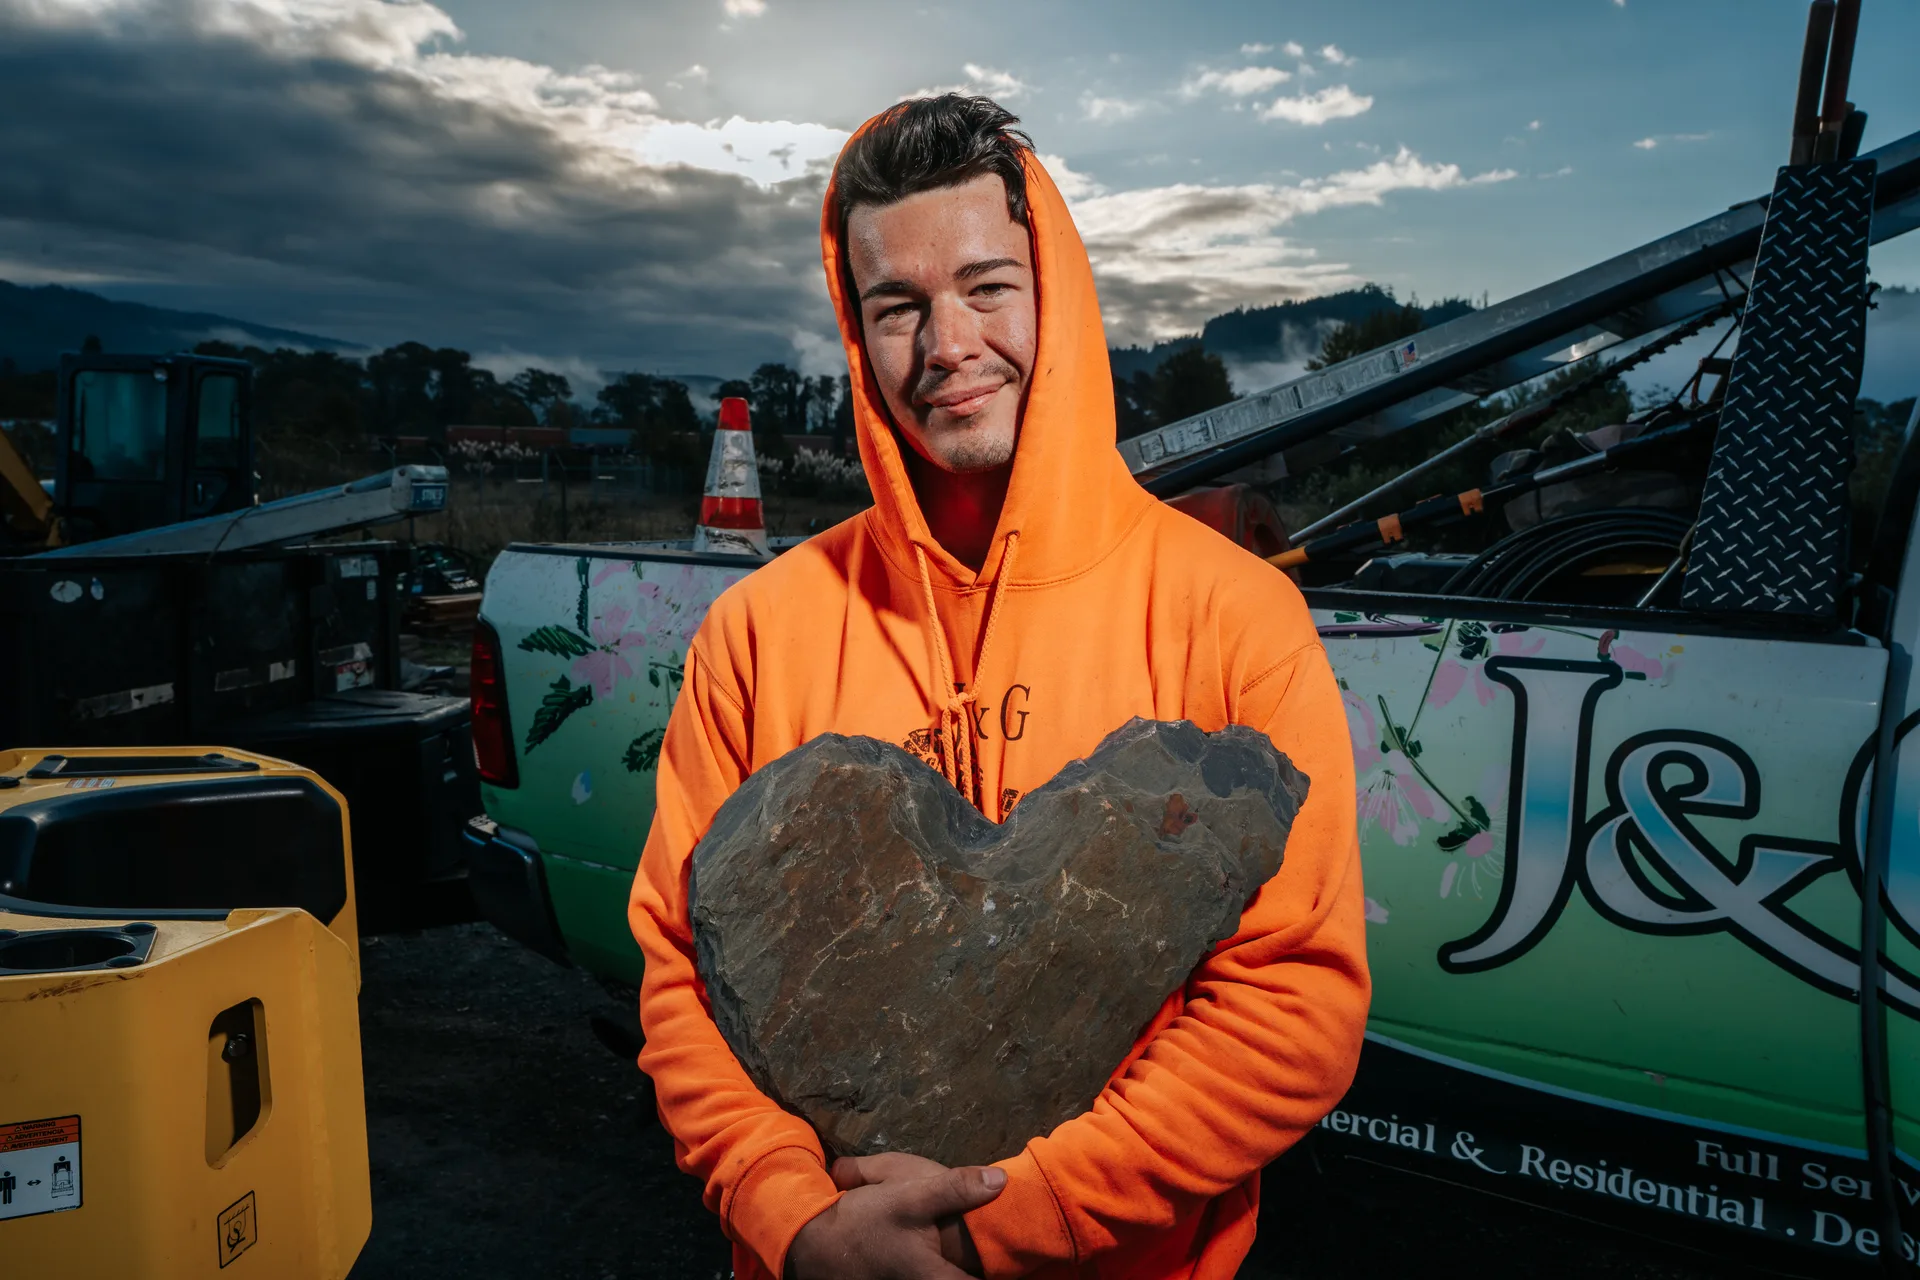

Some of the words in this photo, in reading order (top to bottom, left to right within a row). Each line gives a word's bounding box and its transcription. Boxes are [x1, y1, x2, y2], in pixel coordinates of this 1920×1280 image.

[14, 1128, 65, 1140] ADVERTENCIA
[22, 1121, 56, 1131] WARNING
[1695, 1139, 1782, 1182] Full
[1451, 1131, 1507, 1175] &
[1519, 1144, 1766, 1231] Residential
